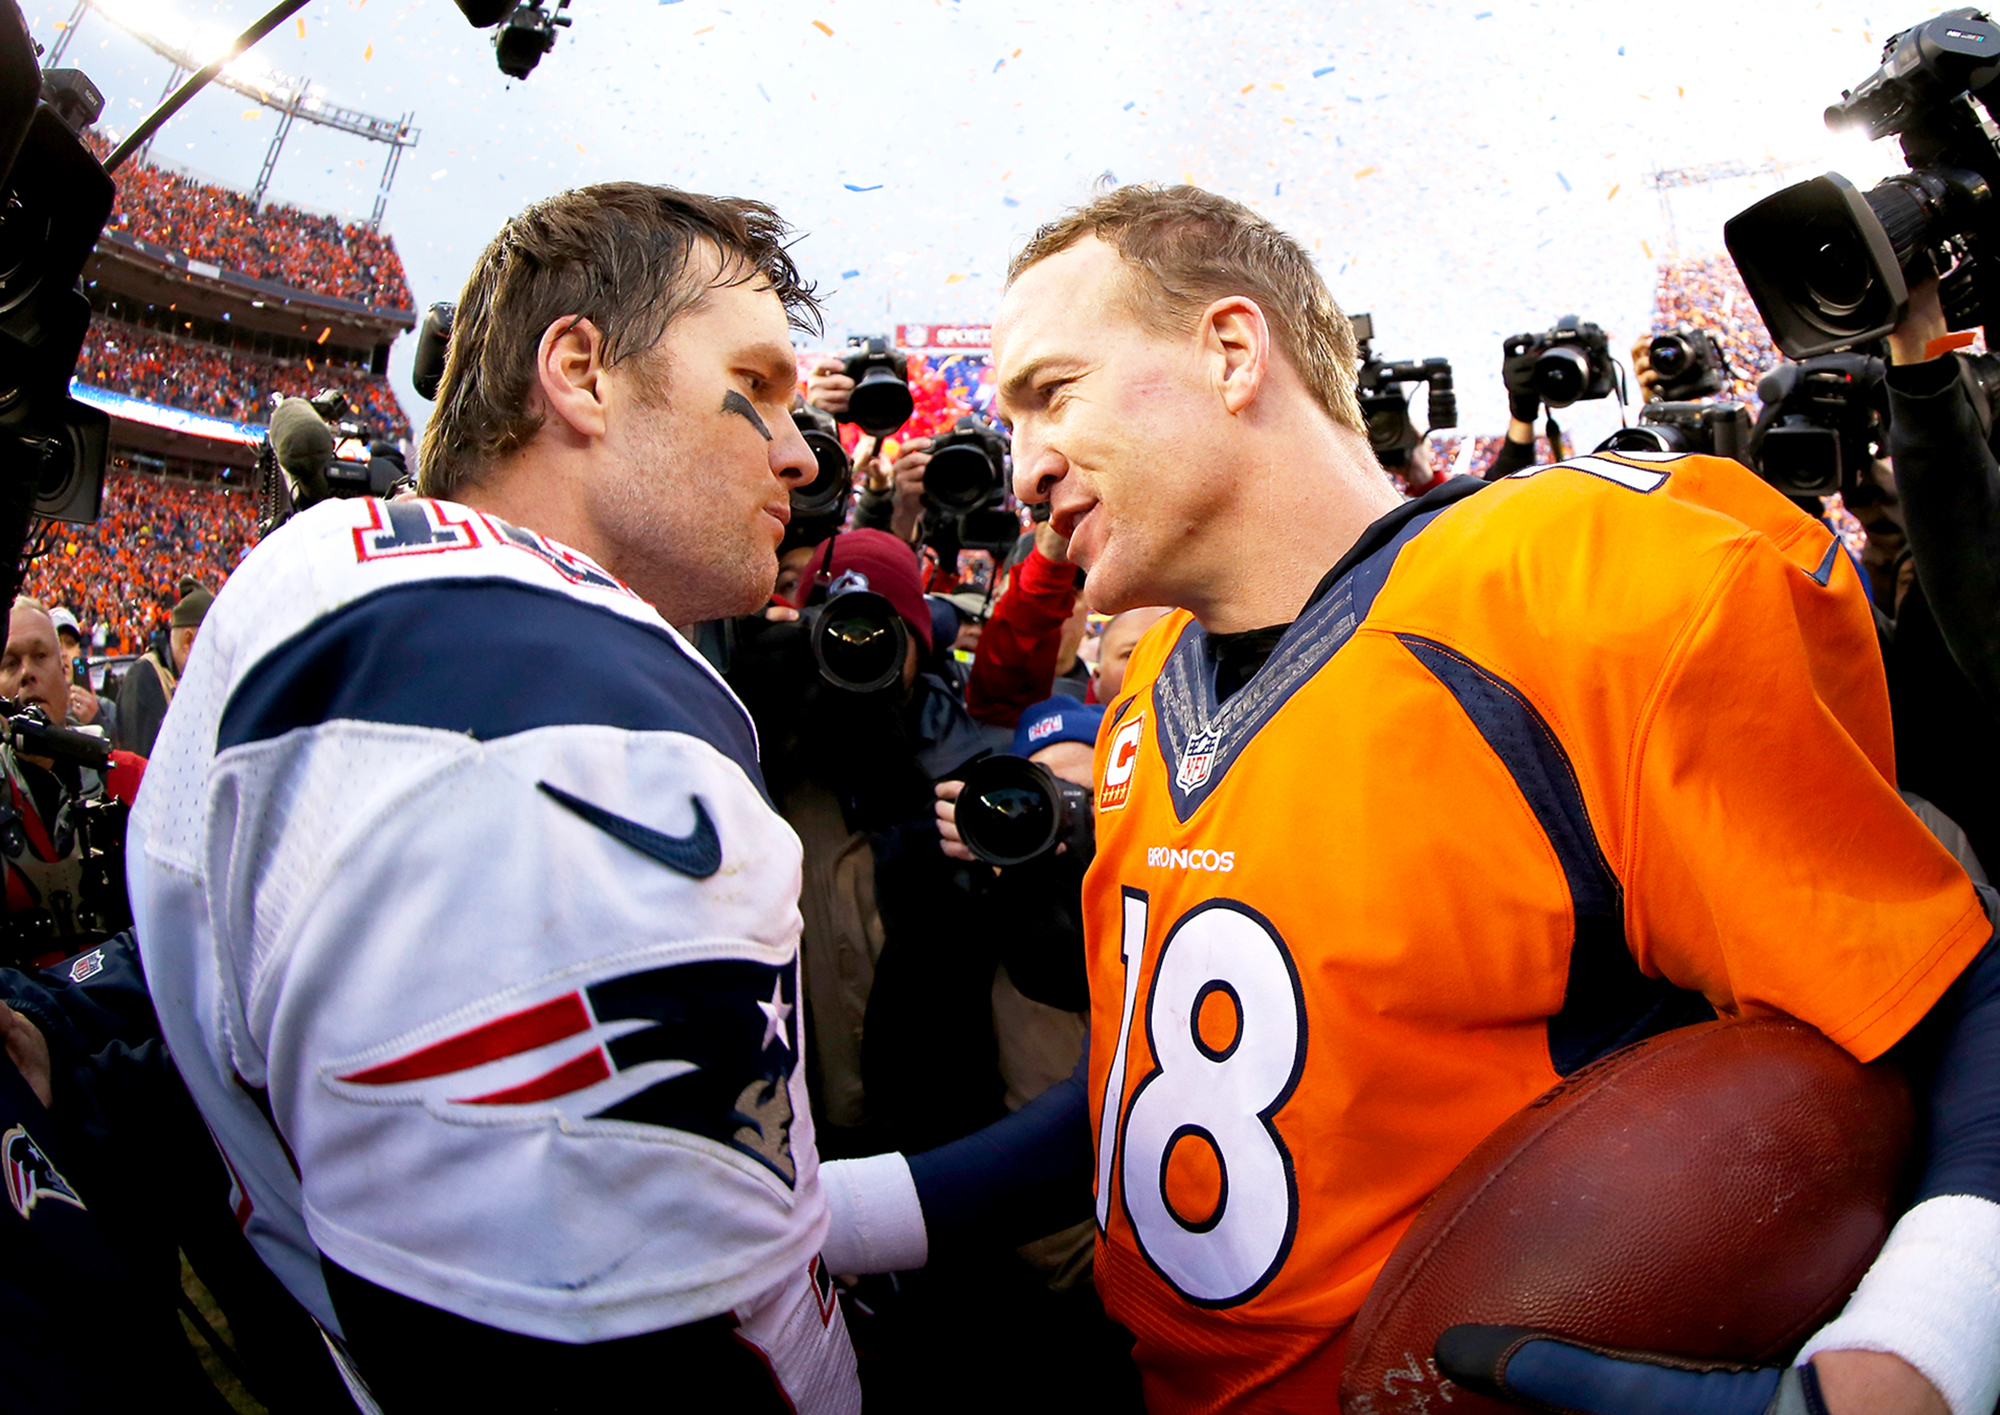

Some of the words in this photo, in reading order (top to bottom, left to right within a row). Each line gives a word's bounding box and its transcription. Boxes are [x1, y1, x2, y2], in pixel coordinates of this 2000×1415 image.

[1033, 721, 1059, 737] NFL
[1106, 720, 1141, 787] C
[1182, 755, 1208, 783] NFL
[1147, 846, 1235, 873] BRONCOS
[1096, 885, 1308, 1310] 18
